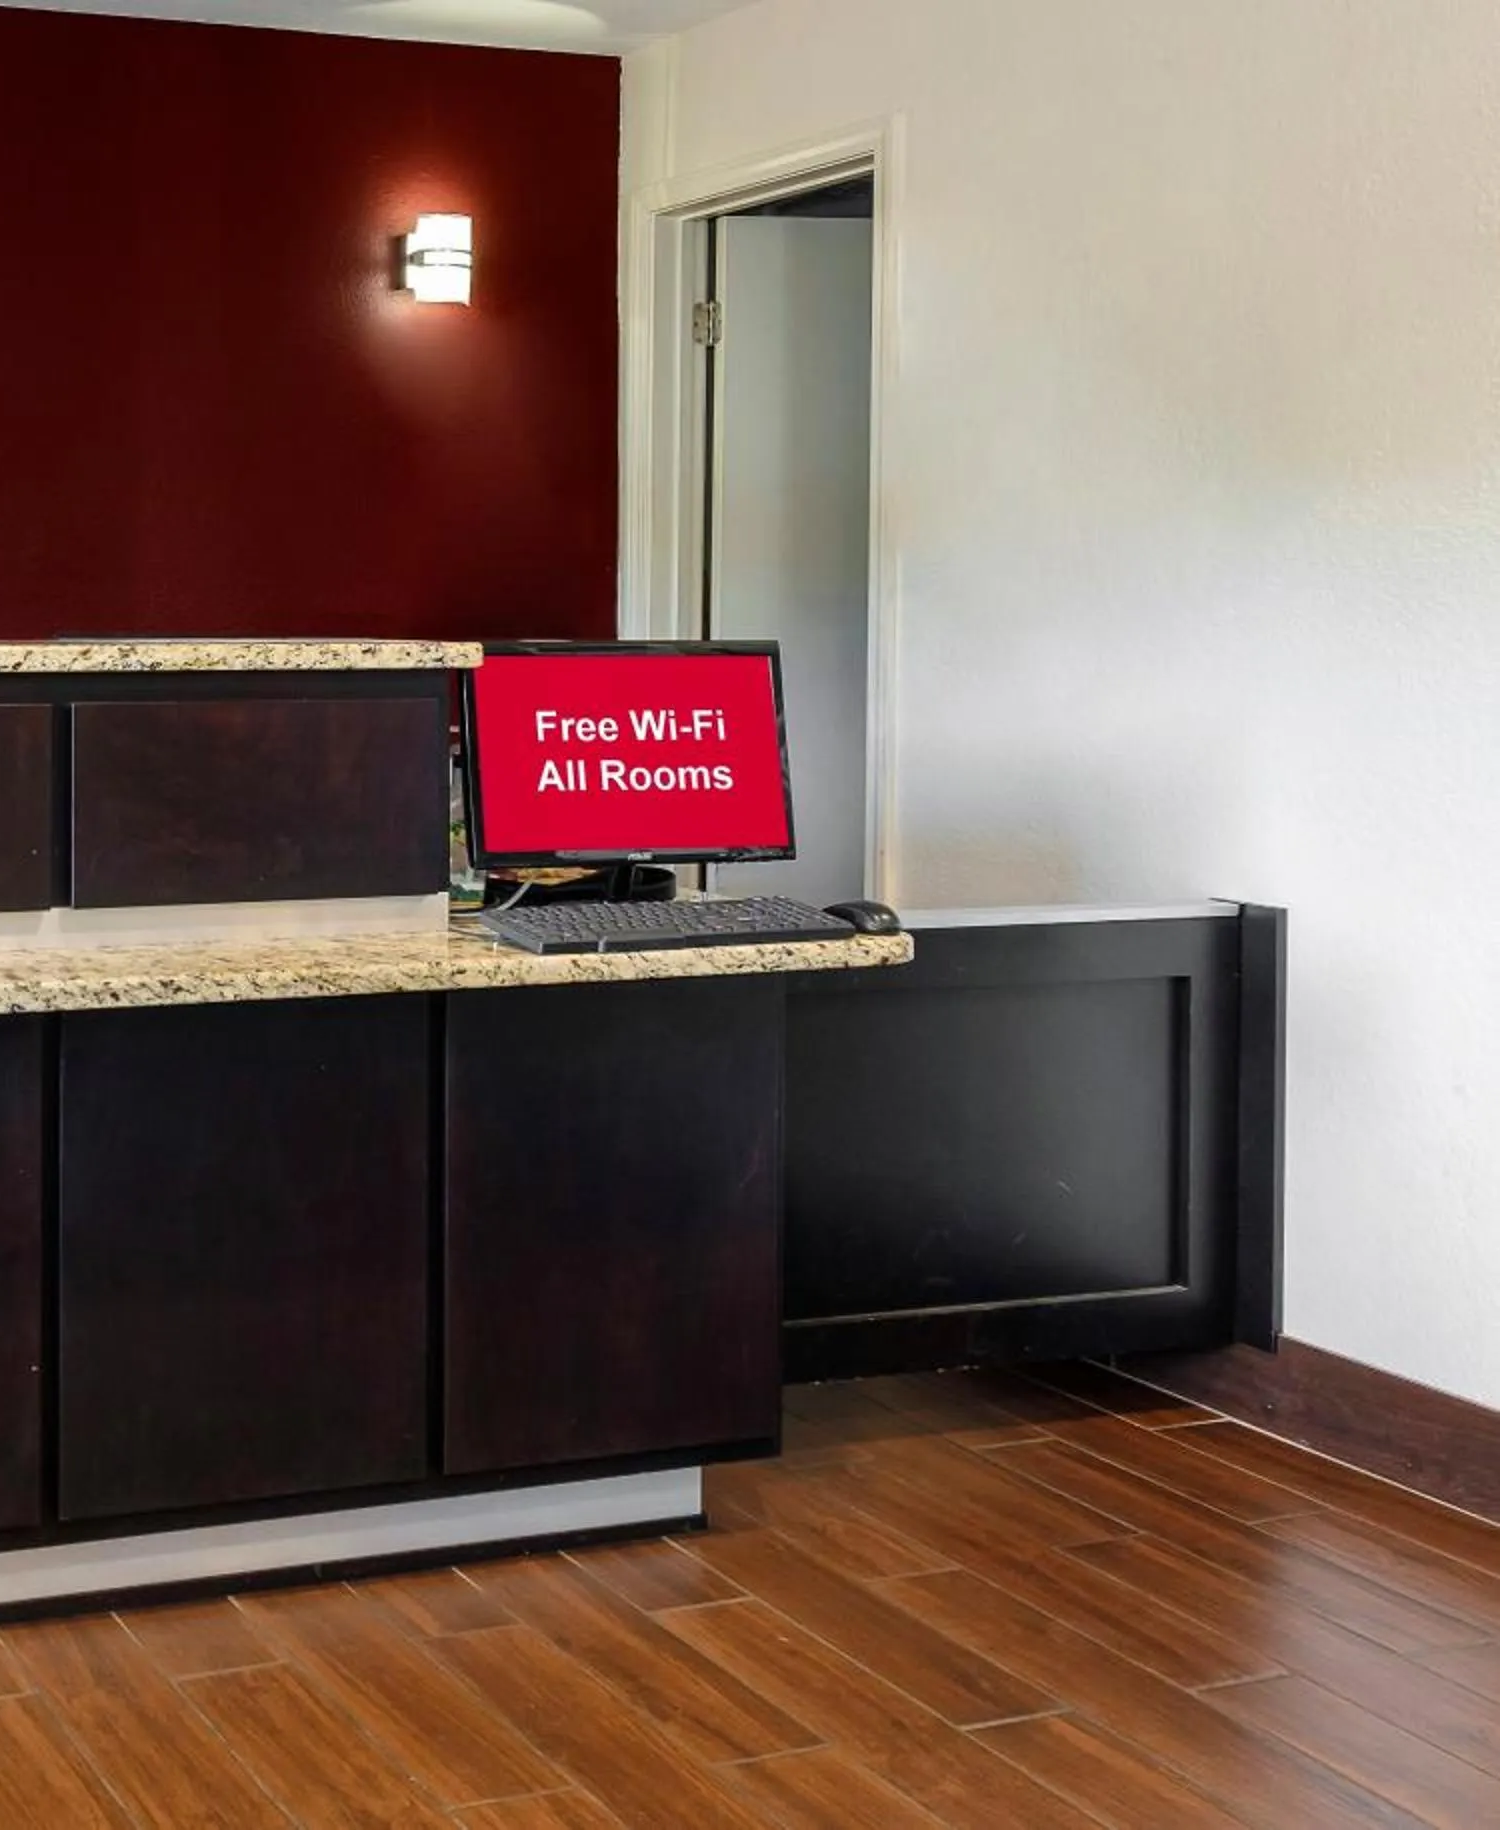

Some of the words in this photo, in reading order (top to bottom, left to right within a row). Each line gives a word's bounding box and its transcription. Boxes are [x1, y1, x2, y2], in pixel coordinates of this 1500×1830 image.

[535, 710, 619, 742] Free
[628, 709, 725, 741] Wi-Fi
[537, 759, 587, 792] All
[600, 759, 734, 791] Rooms
